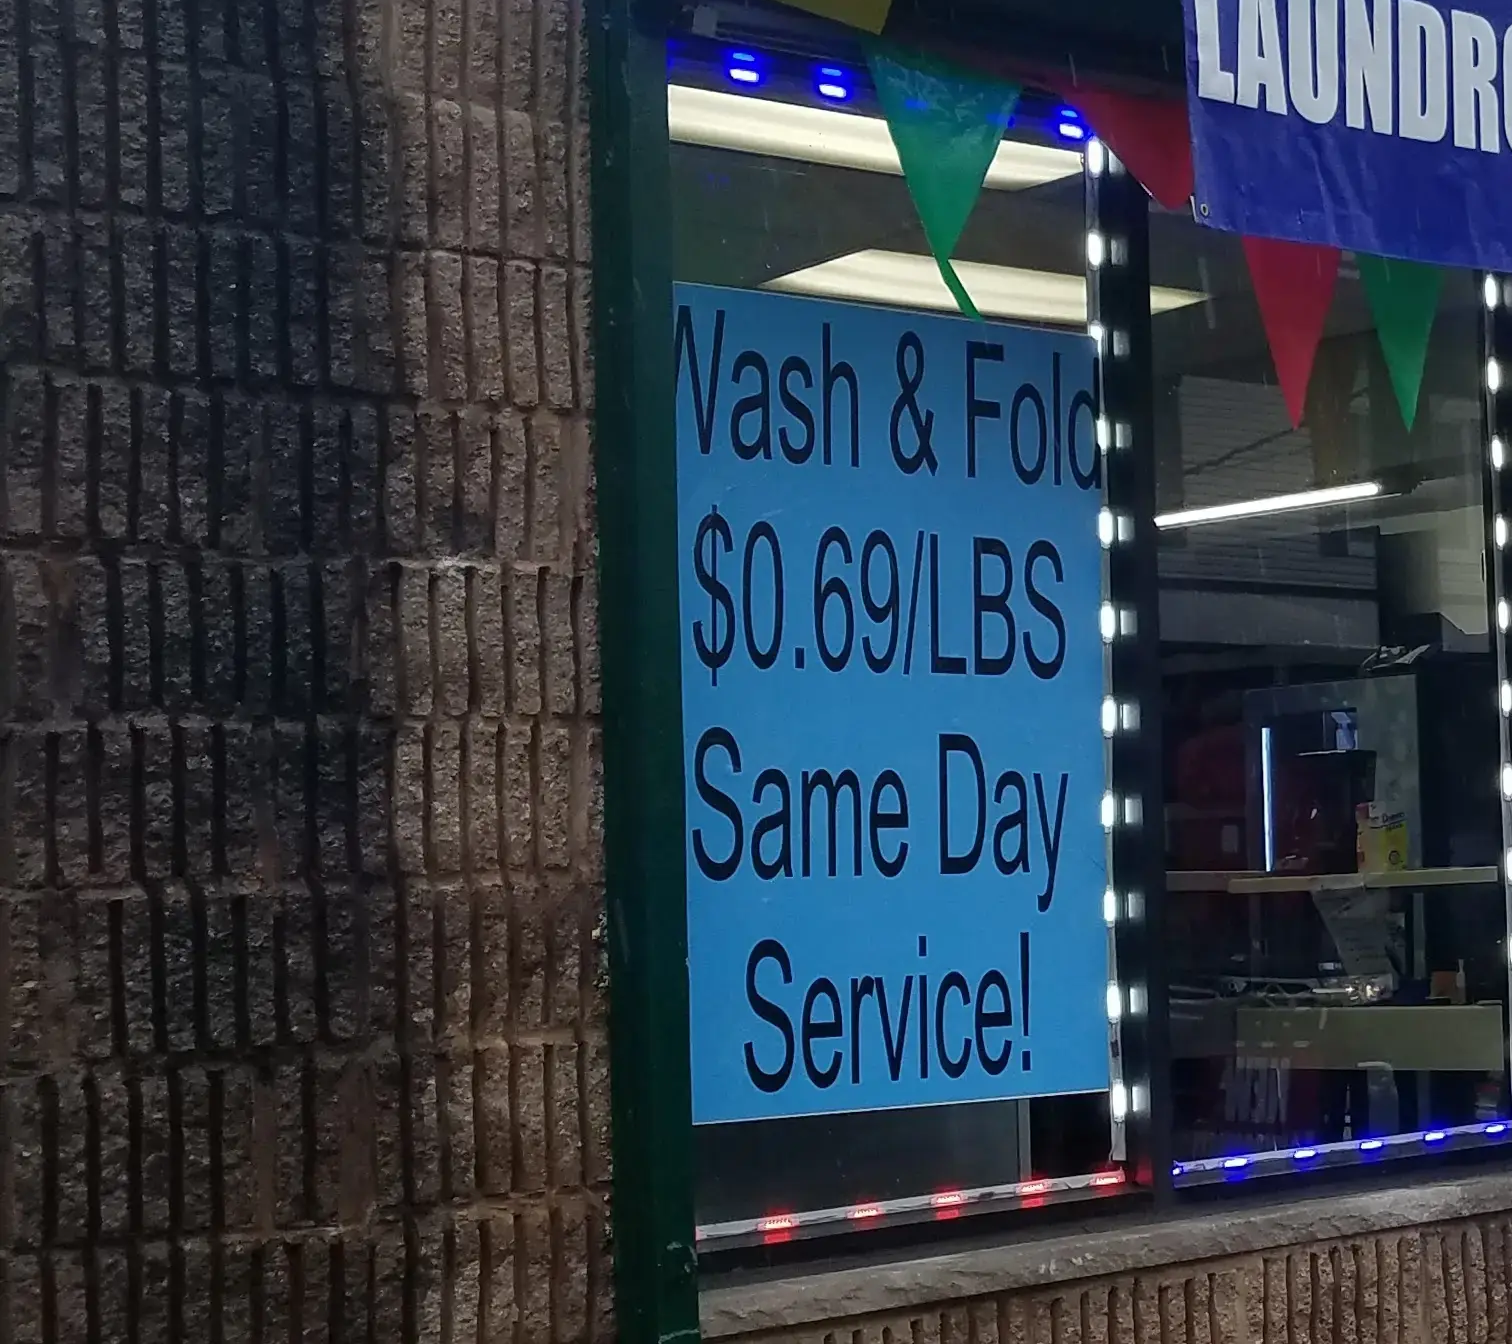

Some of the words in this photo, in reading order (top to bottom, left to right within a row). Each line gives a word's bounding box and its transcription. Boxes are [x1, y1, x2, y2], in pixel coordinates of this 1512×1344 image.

[889, 330, 939, 477] &
[965, 340, 1102, 491] Fold
[693, 503, 1066, 687] $0.69/LBS
[692, 726, 910, 882] Same
[938, 732, 1070, 913] Day
[743, 931, 1033, 1093] Service!
